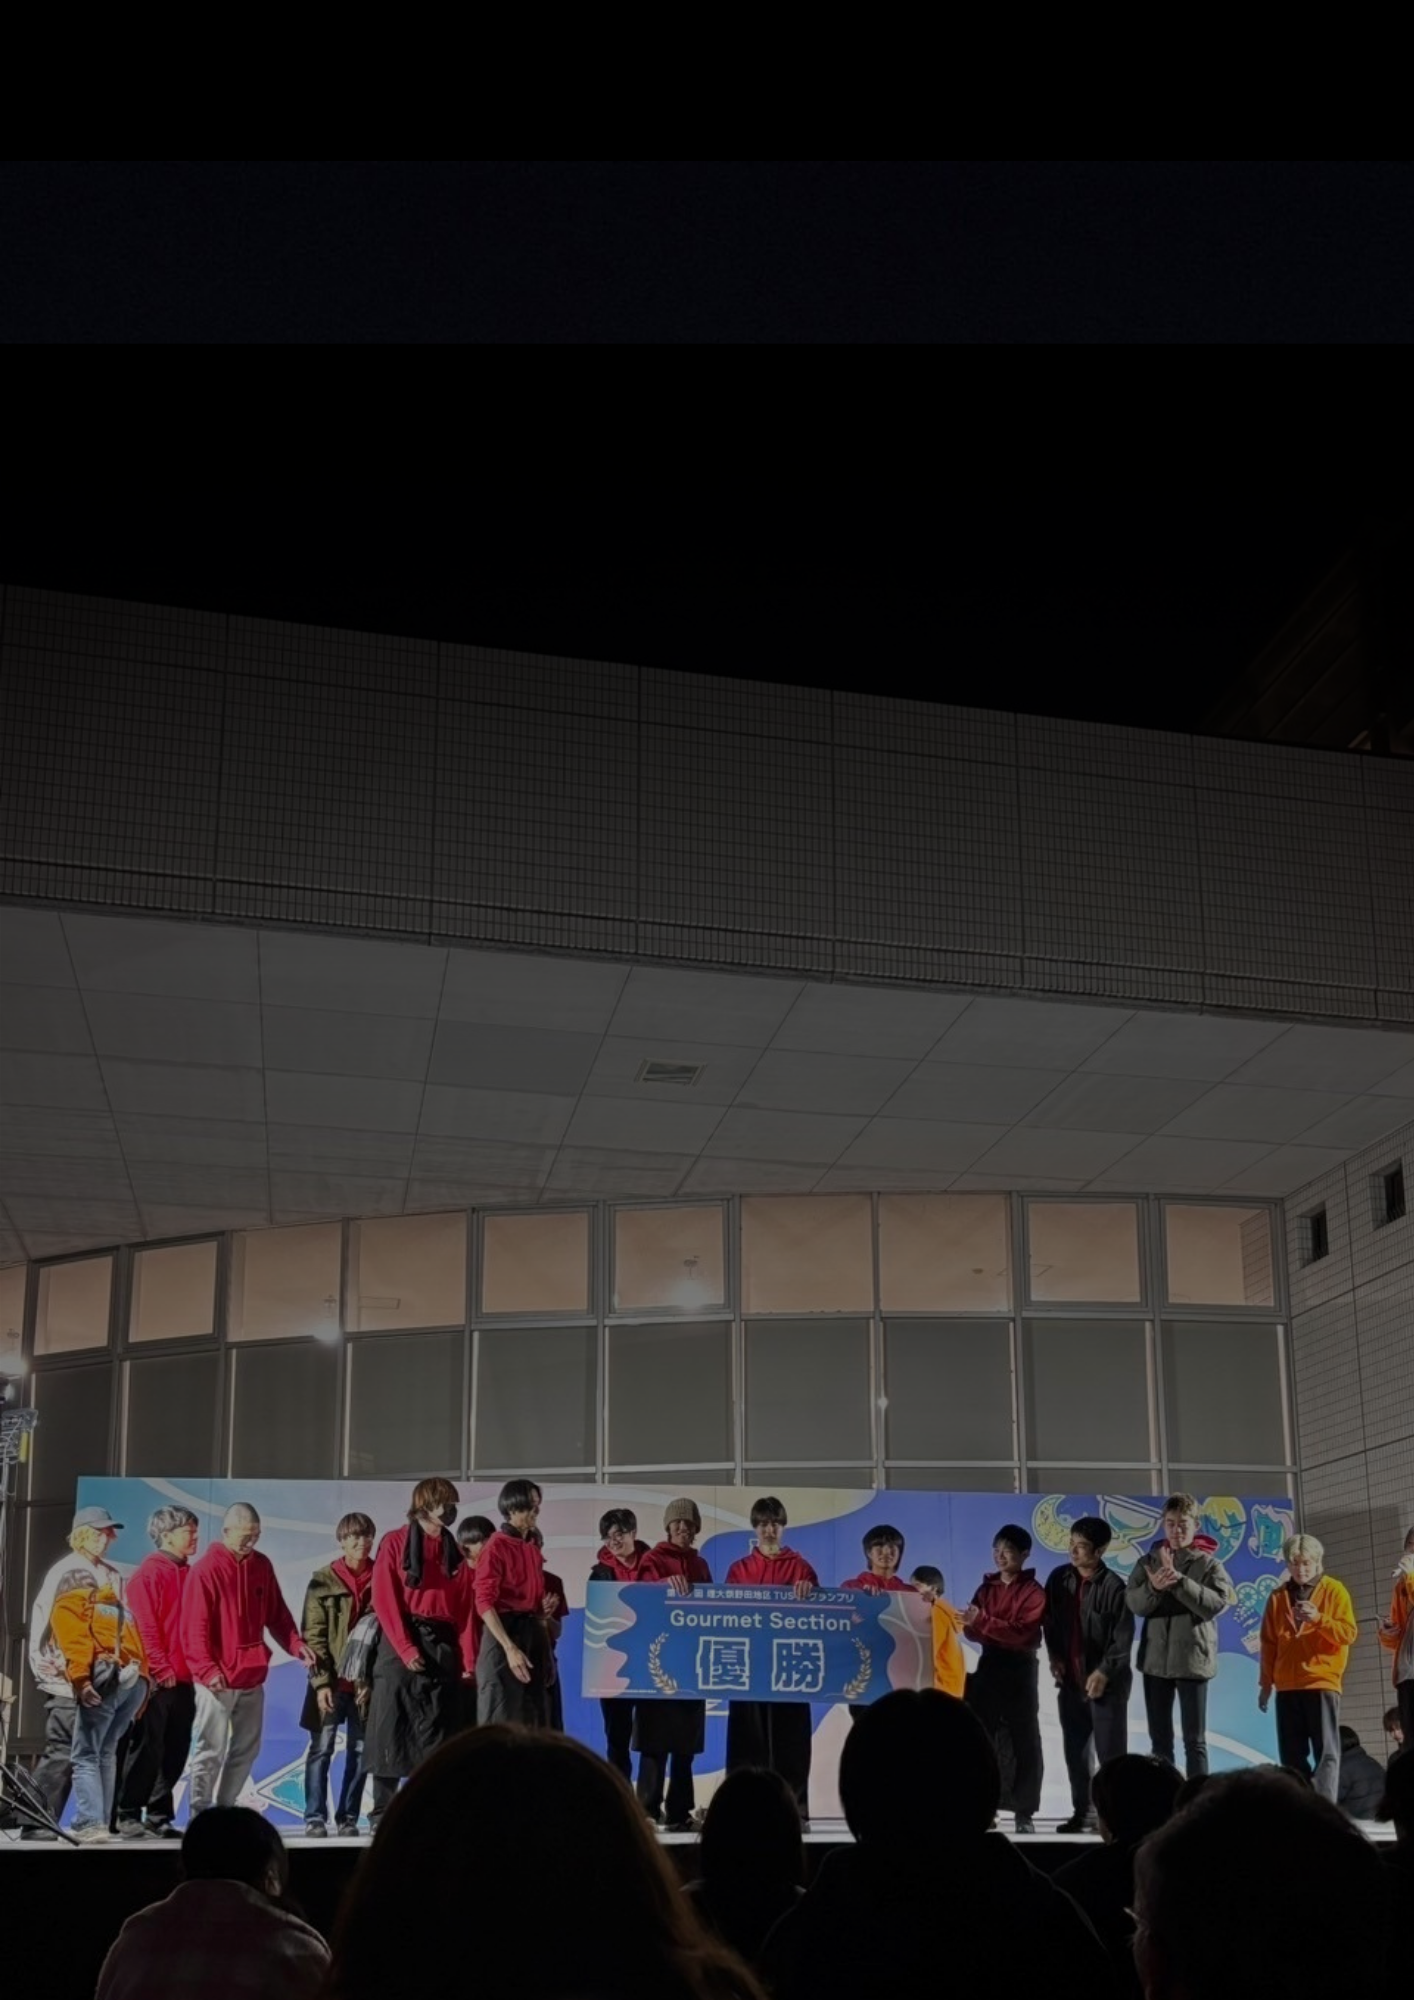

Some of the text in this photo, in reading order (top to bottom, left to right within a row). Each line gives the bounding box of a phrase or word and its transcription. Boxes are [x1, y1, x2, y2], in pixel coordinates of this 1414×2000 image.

[670, 1609, 852, 1631] Gourmet Section
[696, 1636, 825, 1693] 優勝
